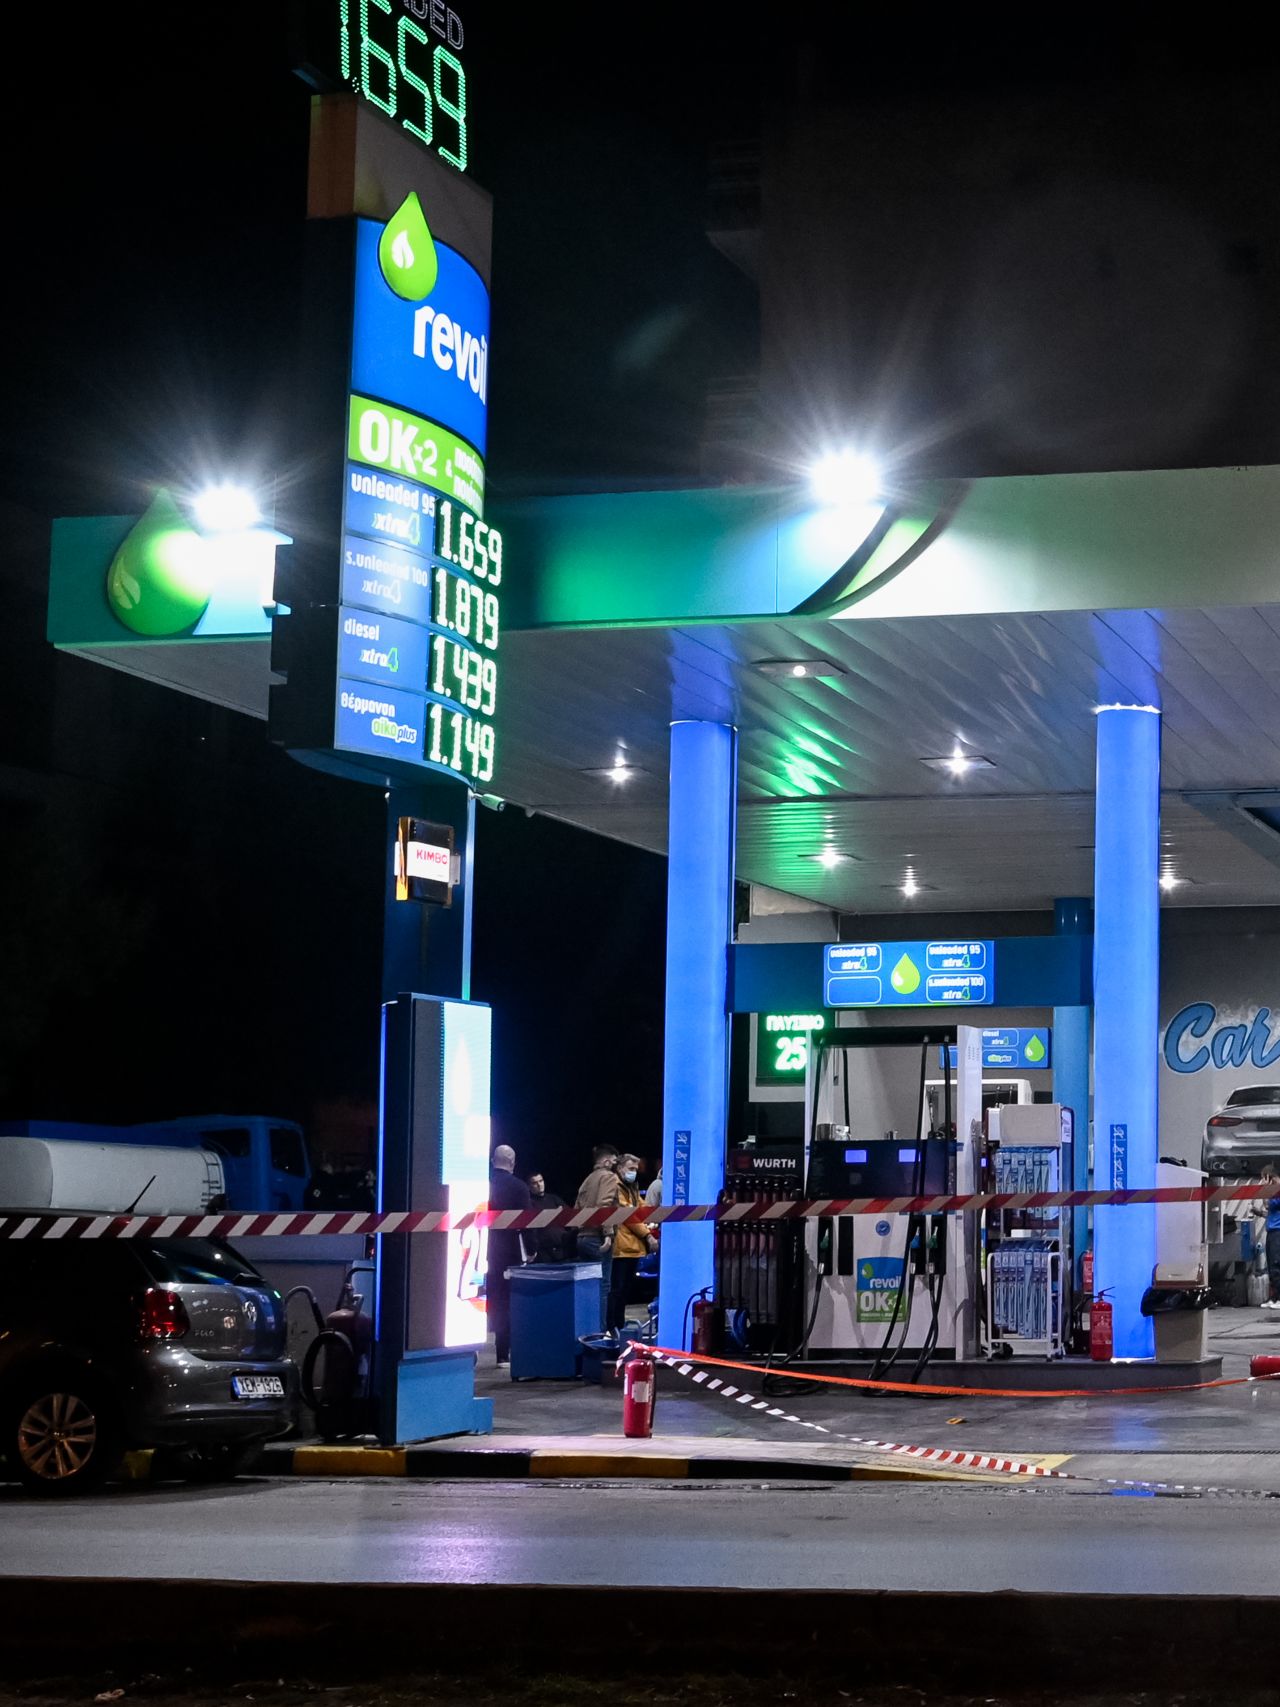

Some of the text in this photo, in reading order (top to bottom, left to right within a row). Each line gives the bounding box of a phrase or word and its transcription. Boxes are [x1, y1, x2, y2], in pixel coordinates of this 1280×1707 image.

[421, 493, 435, 518] 95
[440, 500, 502, 586] 1.659
[412, 566, 428, 588] 100
[435, 568, 499, 650] 1.879
[344, 618, 380, 641] diesel
[433, 635, 497, 716] 1.439
[429, 702, 496, 782] 1.149
[416, 849, 449, 865] KIMBO
[969, 944, 981, 955] 95
[970, 976, 985, 987] 100
[775, 1036, 808, 1071] 25
